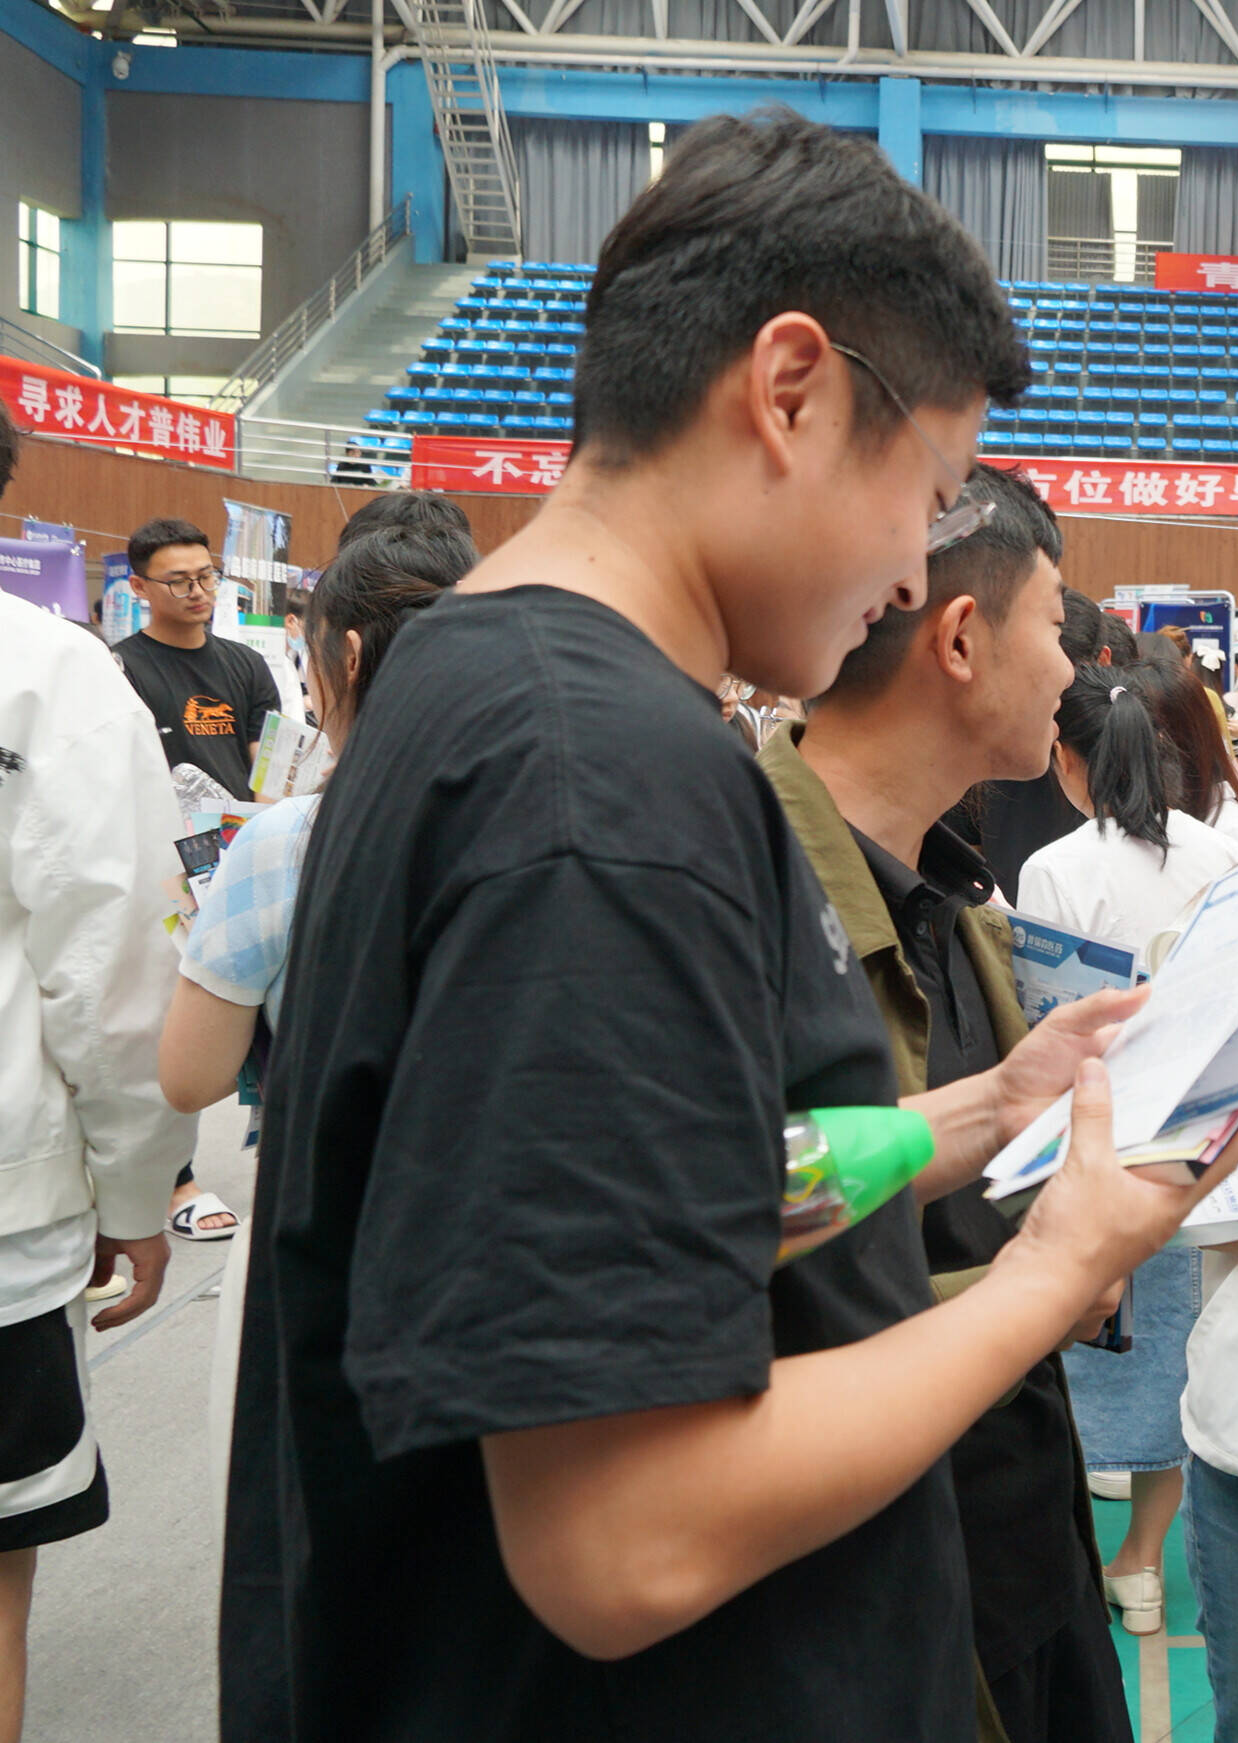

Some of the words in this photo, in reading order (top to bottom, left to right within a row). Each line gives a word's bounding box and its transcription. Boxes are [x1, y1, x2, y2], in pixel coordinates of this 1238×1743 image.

[18, 374, 227, 459] 寻求人才普伟业
[185, 723, 236, 735] VENETA
